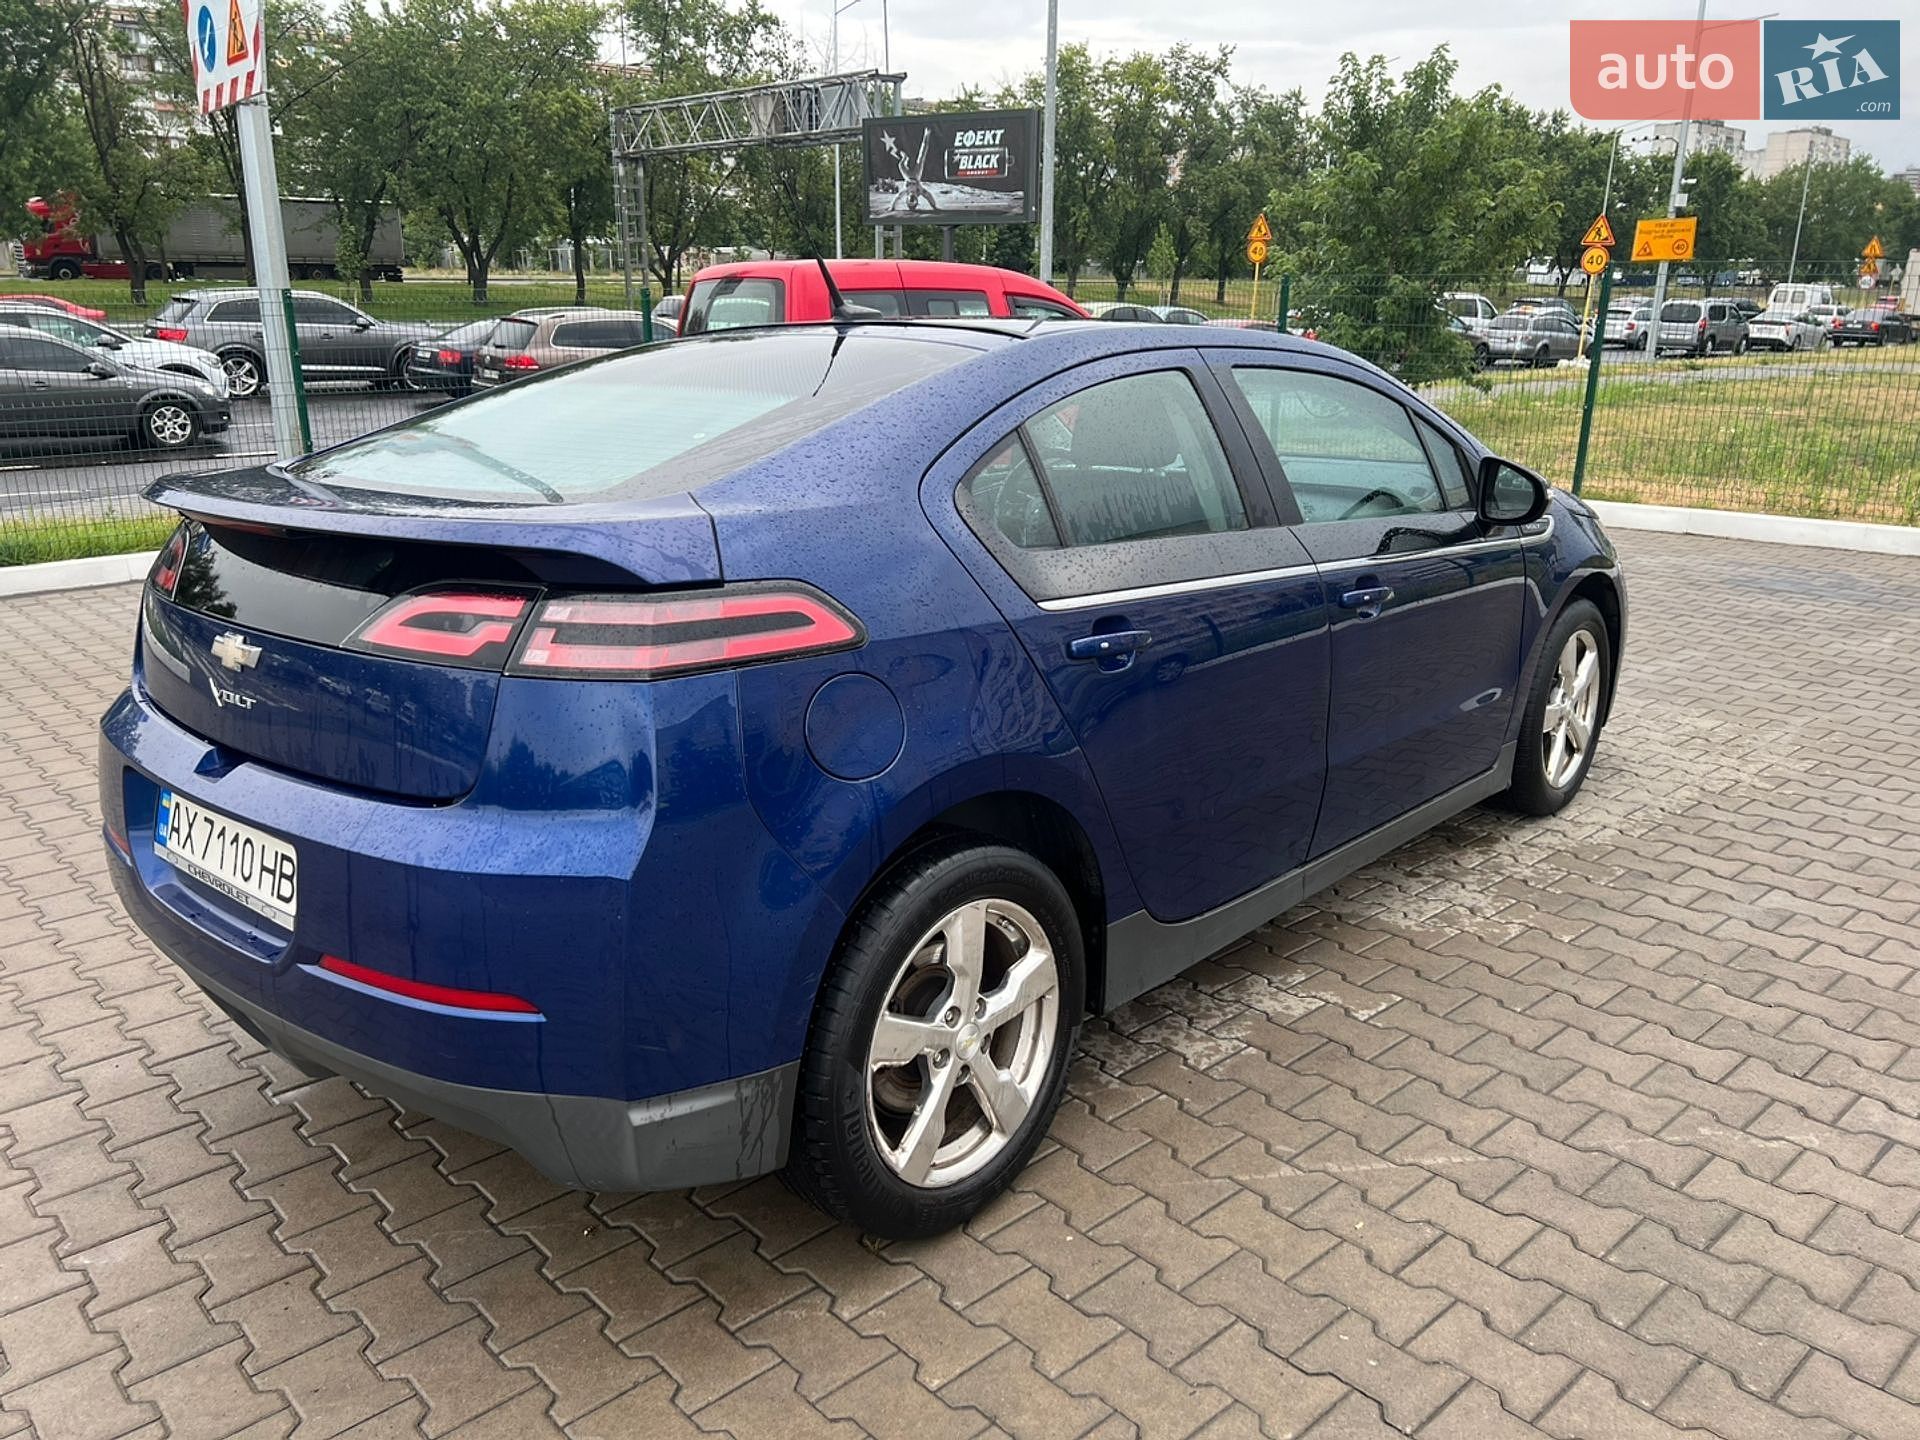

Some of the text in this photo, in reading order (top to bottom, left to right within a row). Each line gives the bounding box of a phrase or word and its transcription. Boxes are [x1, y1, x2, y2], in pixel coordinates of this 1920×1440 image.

[954, 129, 1005, 147] ЕФЕКТ
[958, 154, 1000, 169] BLACK
[1251, 246, 1263, 256] 40
[1675, 243, 1685, 251] 40
[1586, 254, 1603, 265] 40
[209, 677, 257, 710] VOLT
[169, 801, 296, 905] AX 7110 HB
[186, 863, 251, 906] CHEVROLET
